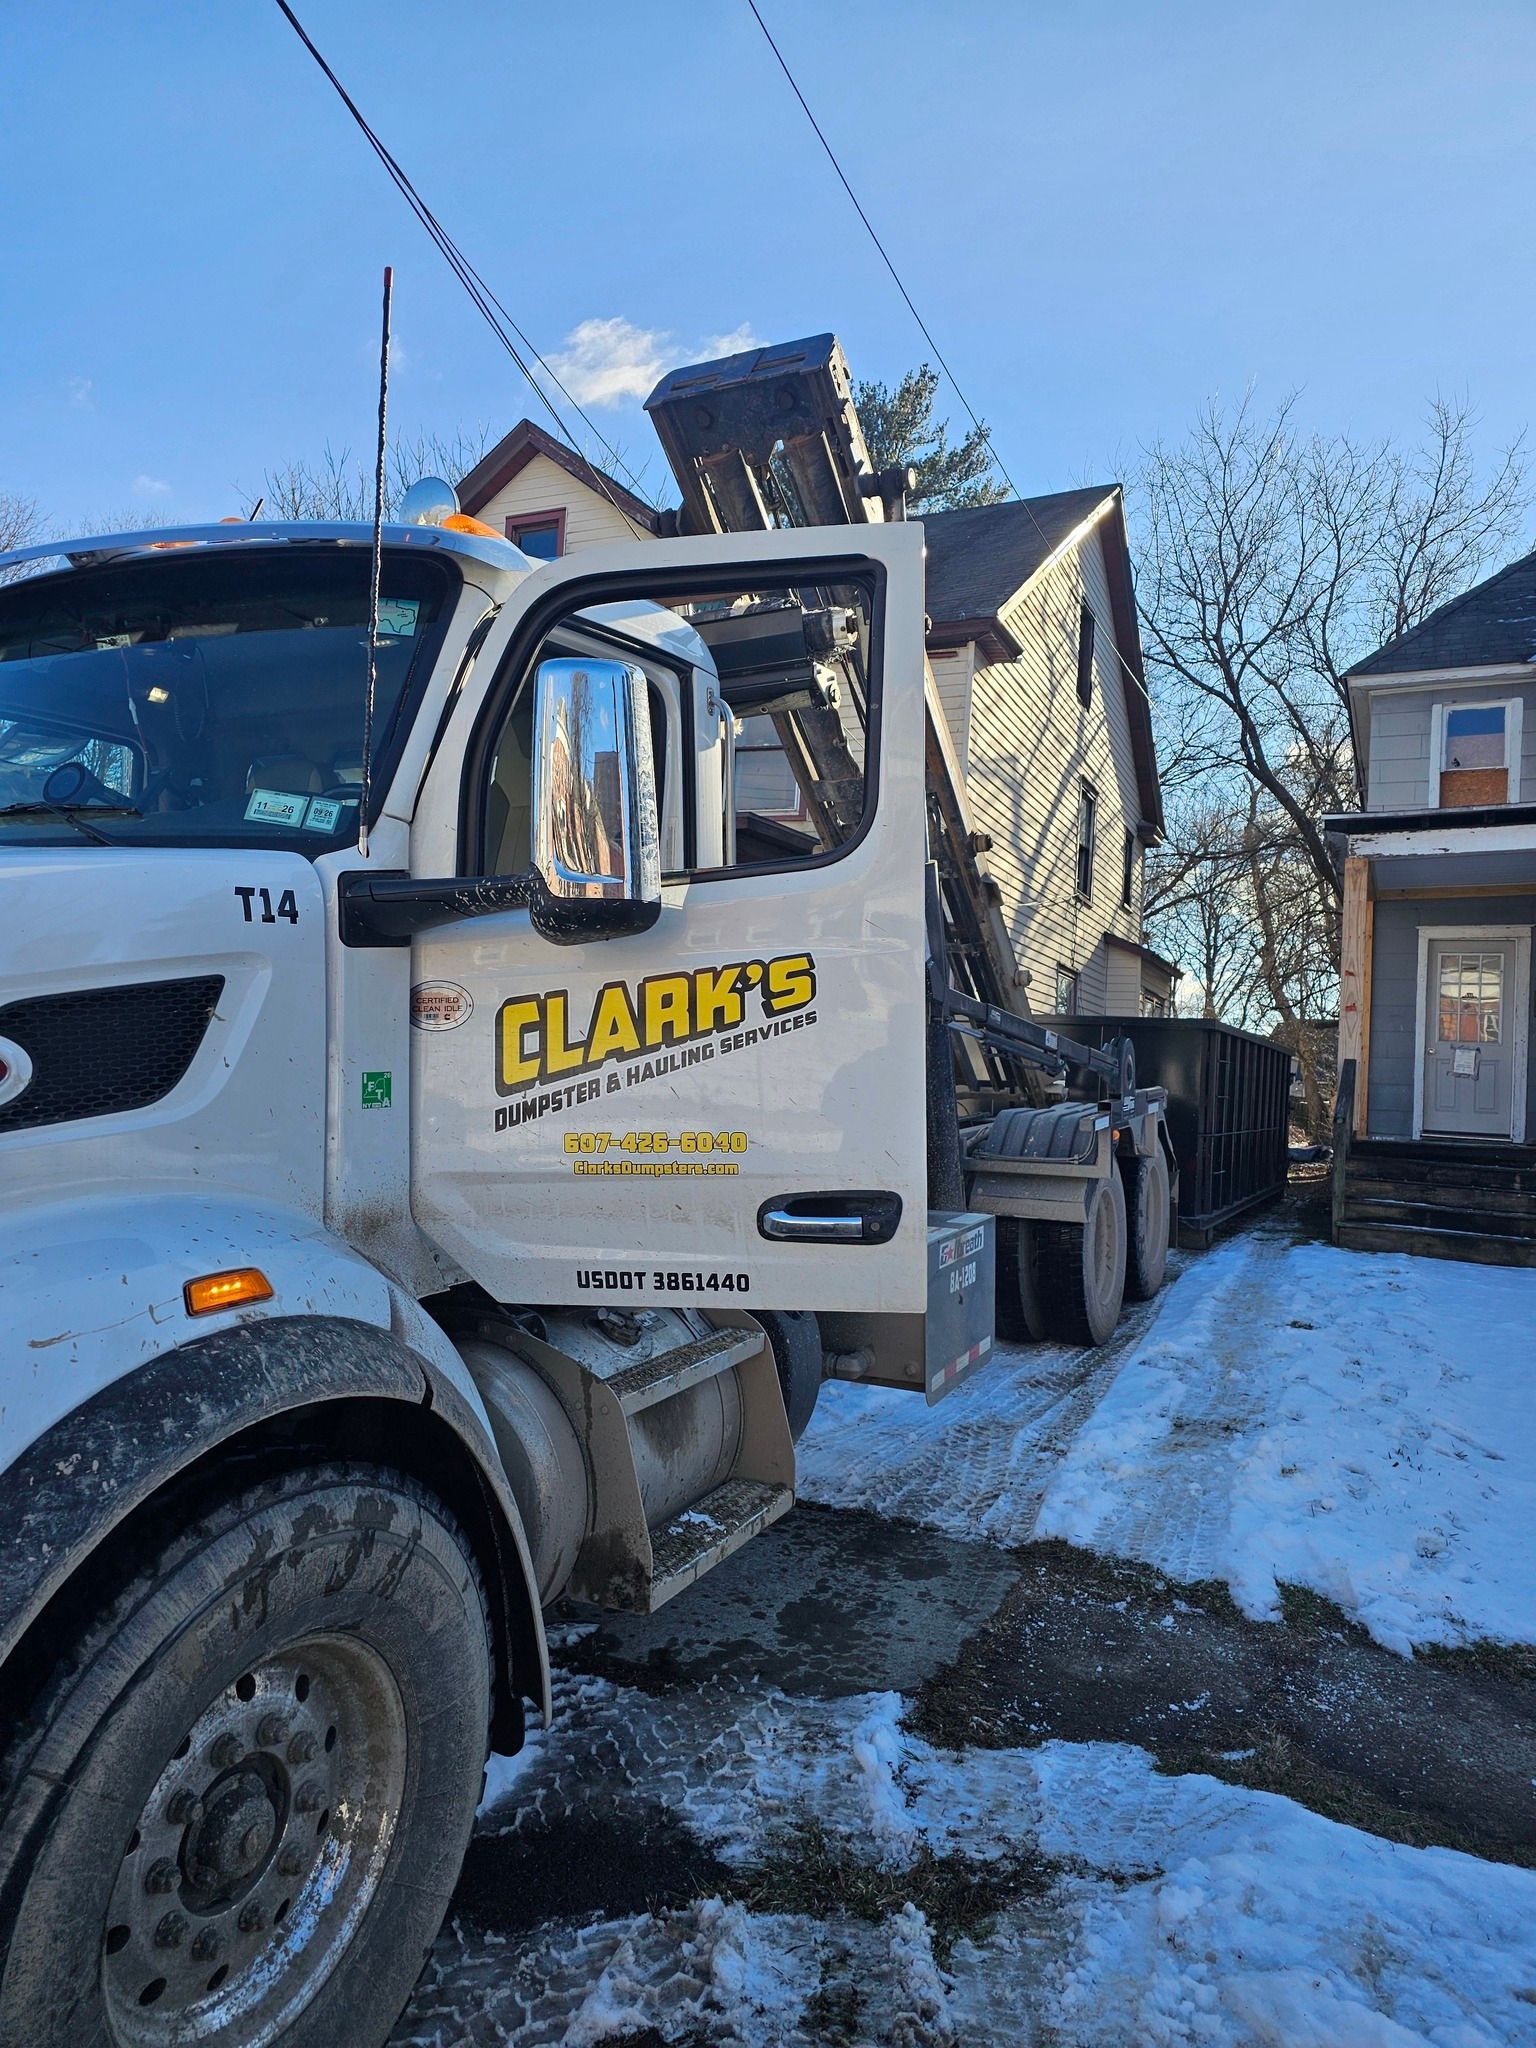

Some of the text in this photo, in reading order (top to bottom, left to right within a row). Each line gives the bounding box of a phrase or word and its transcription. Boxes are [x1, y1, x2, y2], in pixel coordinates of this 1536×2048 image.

[257, 801, 295, 814] 11 26
[234, 886, 299, 925] T14
[412, 1004, 463, 1013] CLEAN IDLE
[416, 996, 460, 1004] CERTIFIED
[495, 952, 817, 1097] CLARK'S
[494, 1010, 818, 1133] DUMPSTER & HAULING SERVICES
[563, 1131, 748, 1154] 607-426-6040
[573, 1160, 739, 1178] ClarksDumpsters.com
[576, 1270, 750, 1292] USDOT 3861440
